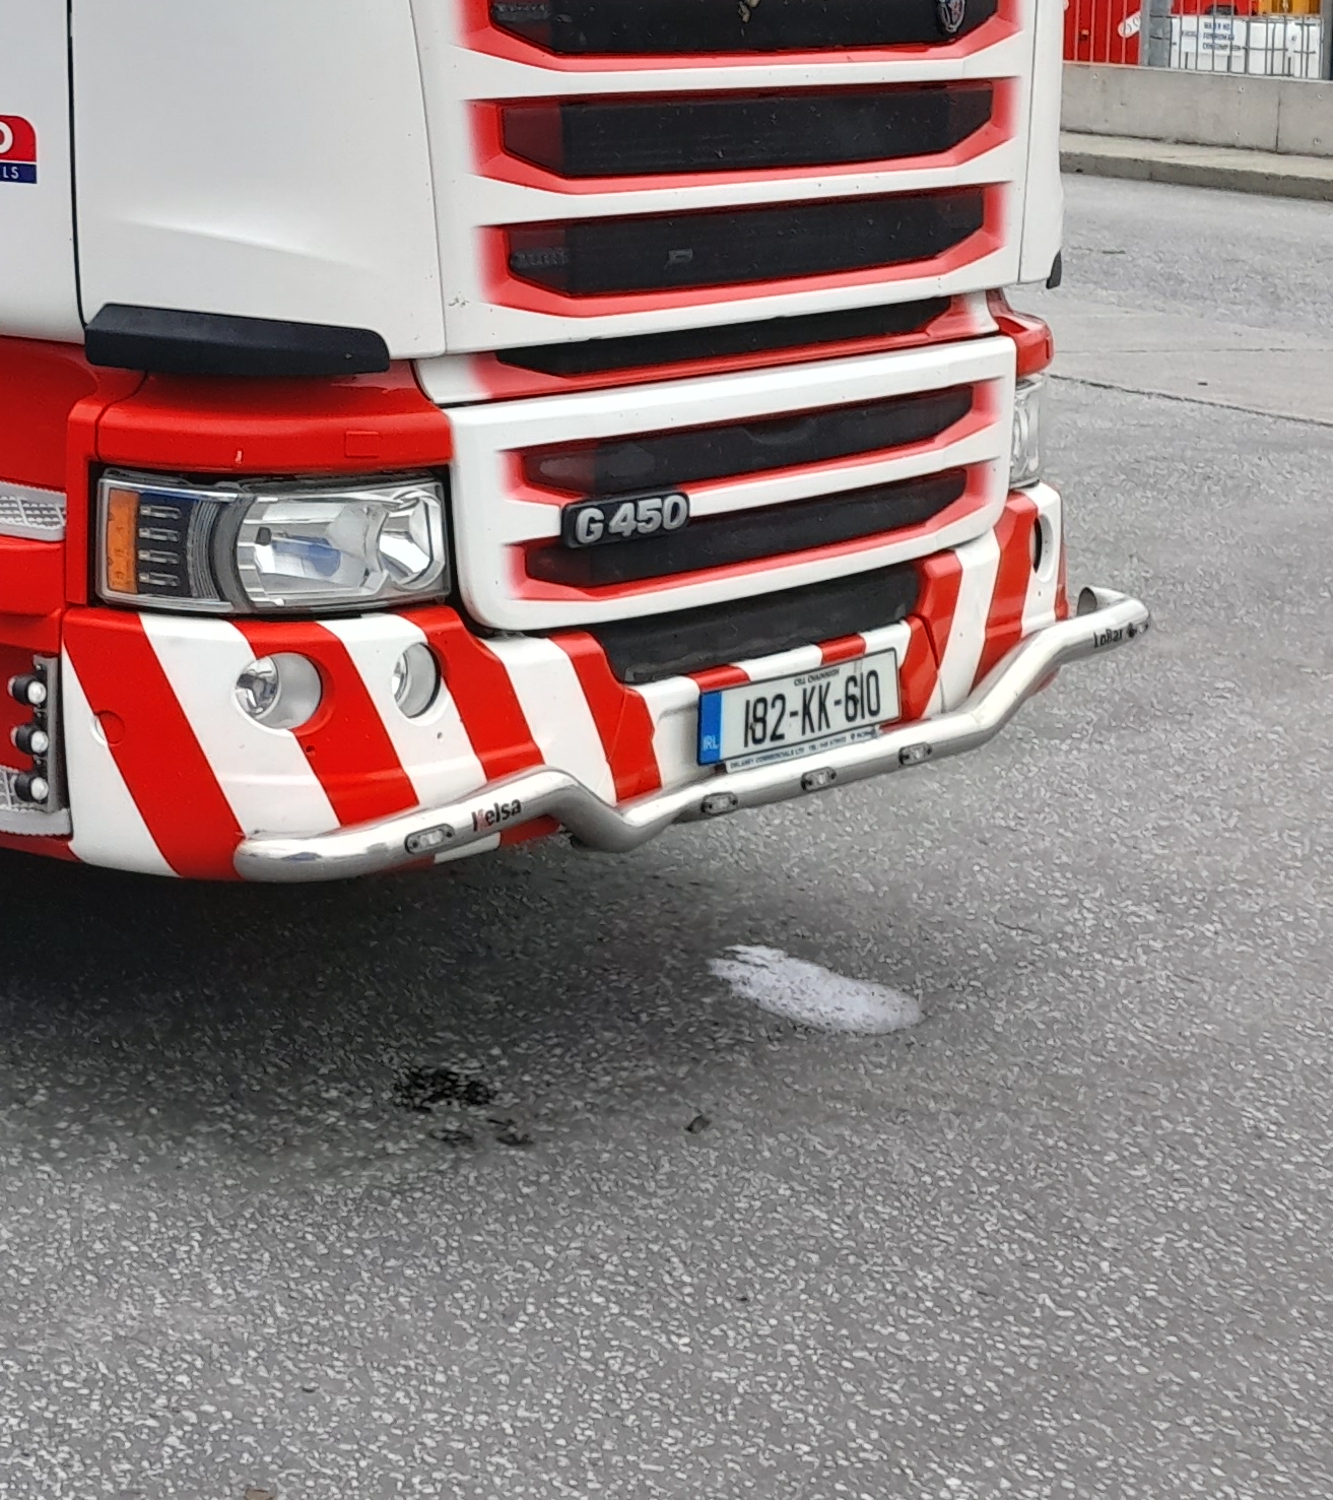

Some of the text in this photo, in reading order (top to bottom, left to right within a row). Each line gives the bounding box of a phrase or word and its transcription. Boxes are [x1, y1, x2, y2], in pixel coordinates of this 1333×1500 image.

[575, 494, 688, 544] G 450
[744, 669, 881, 748] 182-KK-610
[703, 734, 720, 750] IRL
